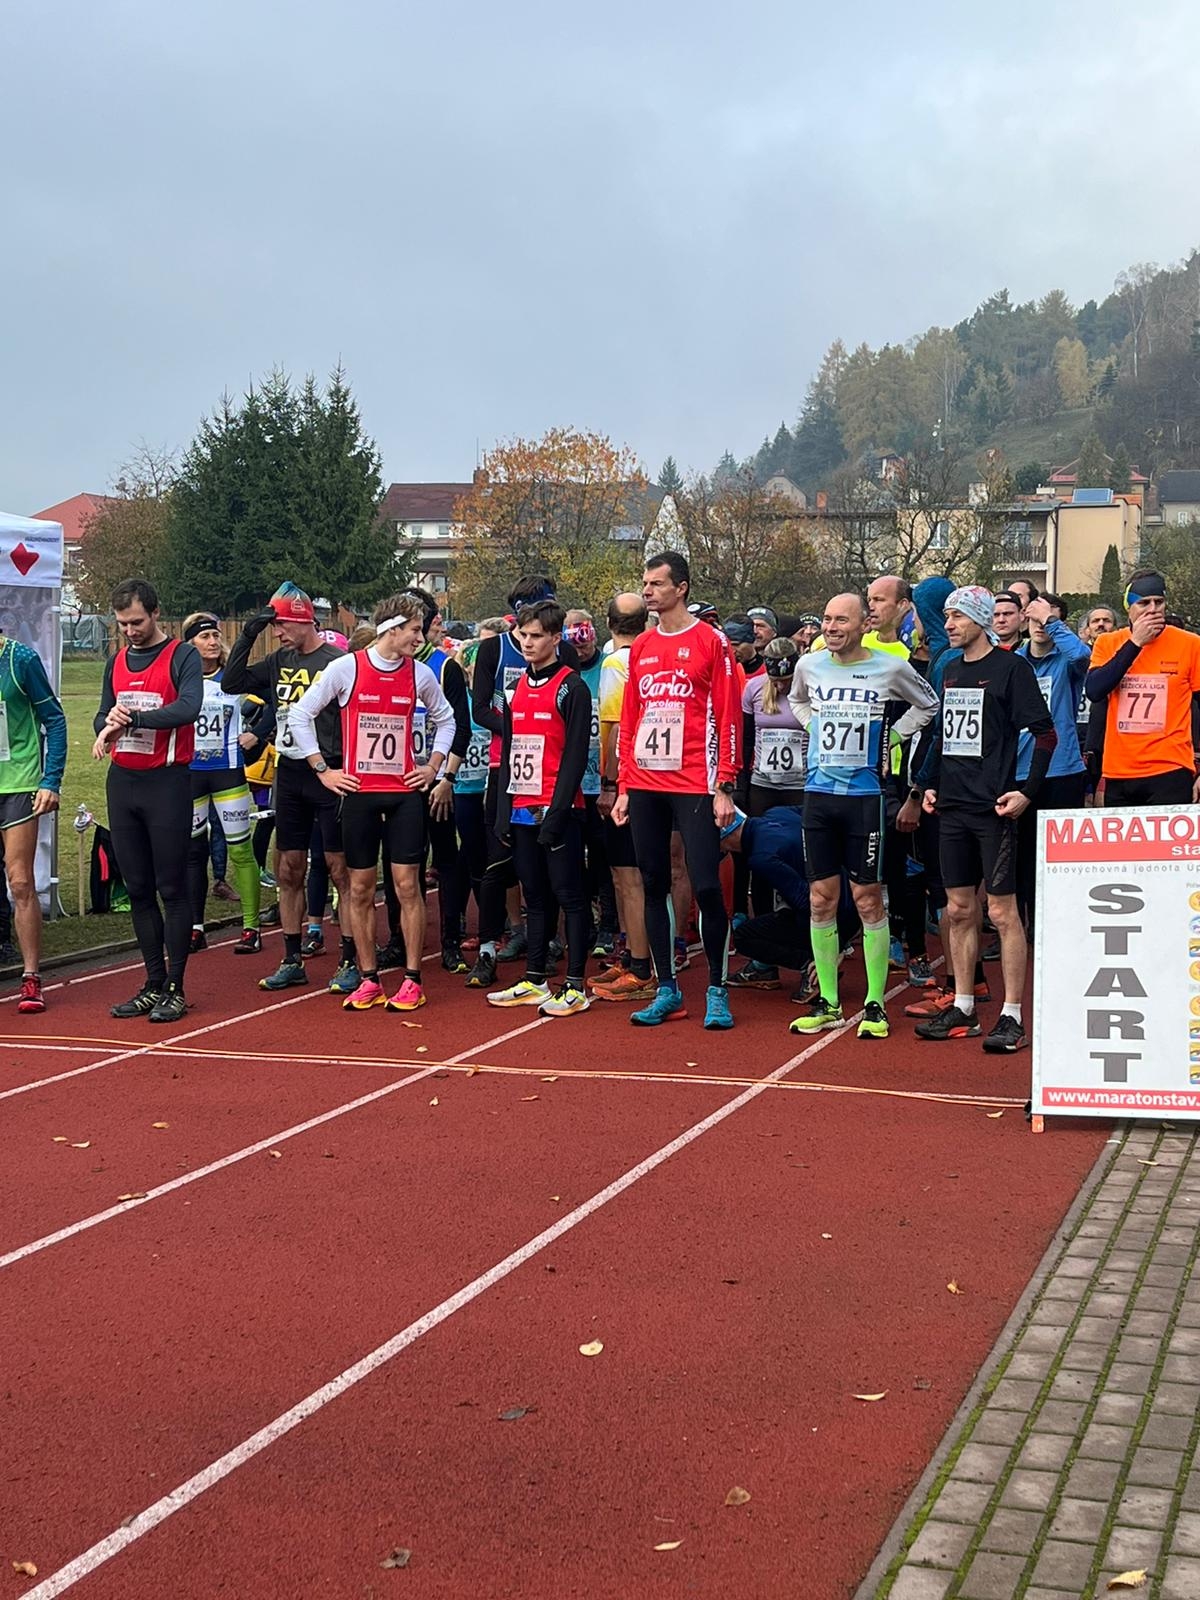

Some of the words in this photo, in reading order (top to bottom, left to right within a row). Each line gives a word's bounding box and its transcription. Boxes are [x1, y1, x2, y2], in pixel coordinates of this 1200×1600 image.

[639, 672, 694, 699] Carla
[815, 685, 880, 704] ASTER
[1127, 692, 1157, 719] 77
[196, 715, 222, 738] 84
[360, 722, 388, 730] BĚŽECKÁ
[822, 721, 866, 751] 371
[944, 709, 979, 740] 375
[366, 732, 397, 761] 70
[645, 728, 671, 756] 41
[513, 753, 535, 781] 55
[767, 745, 794, 771] 49
[1046, 814, 1200, 844] MARATO
[1047, 864, 1128, 875] tělovýchovná
[1133, 863, 1181, 874] jednota
[1083, 883, 1148, 1083] START
[1047, 1090, 1200, 1108] www.maratonstav.
